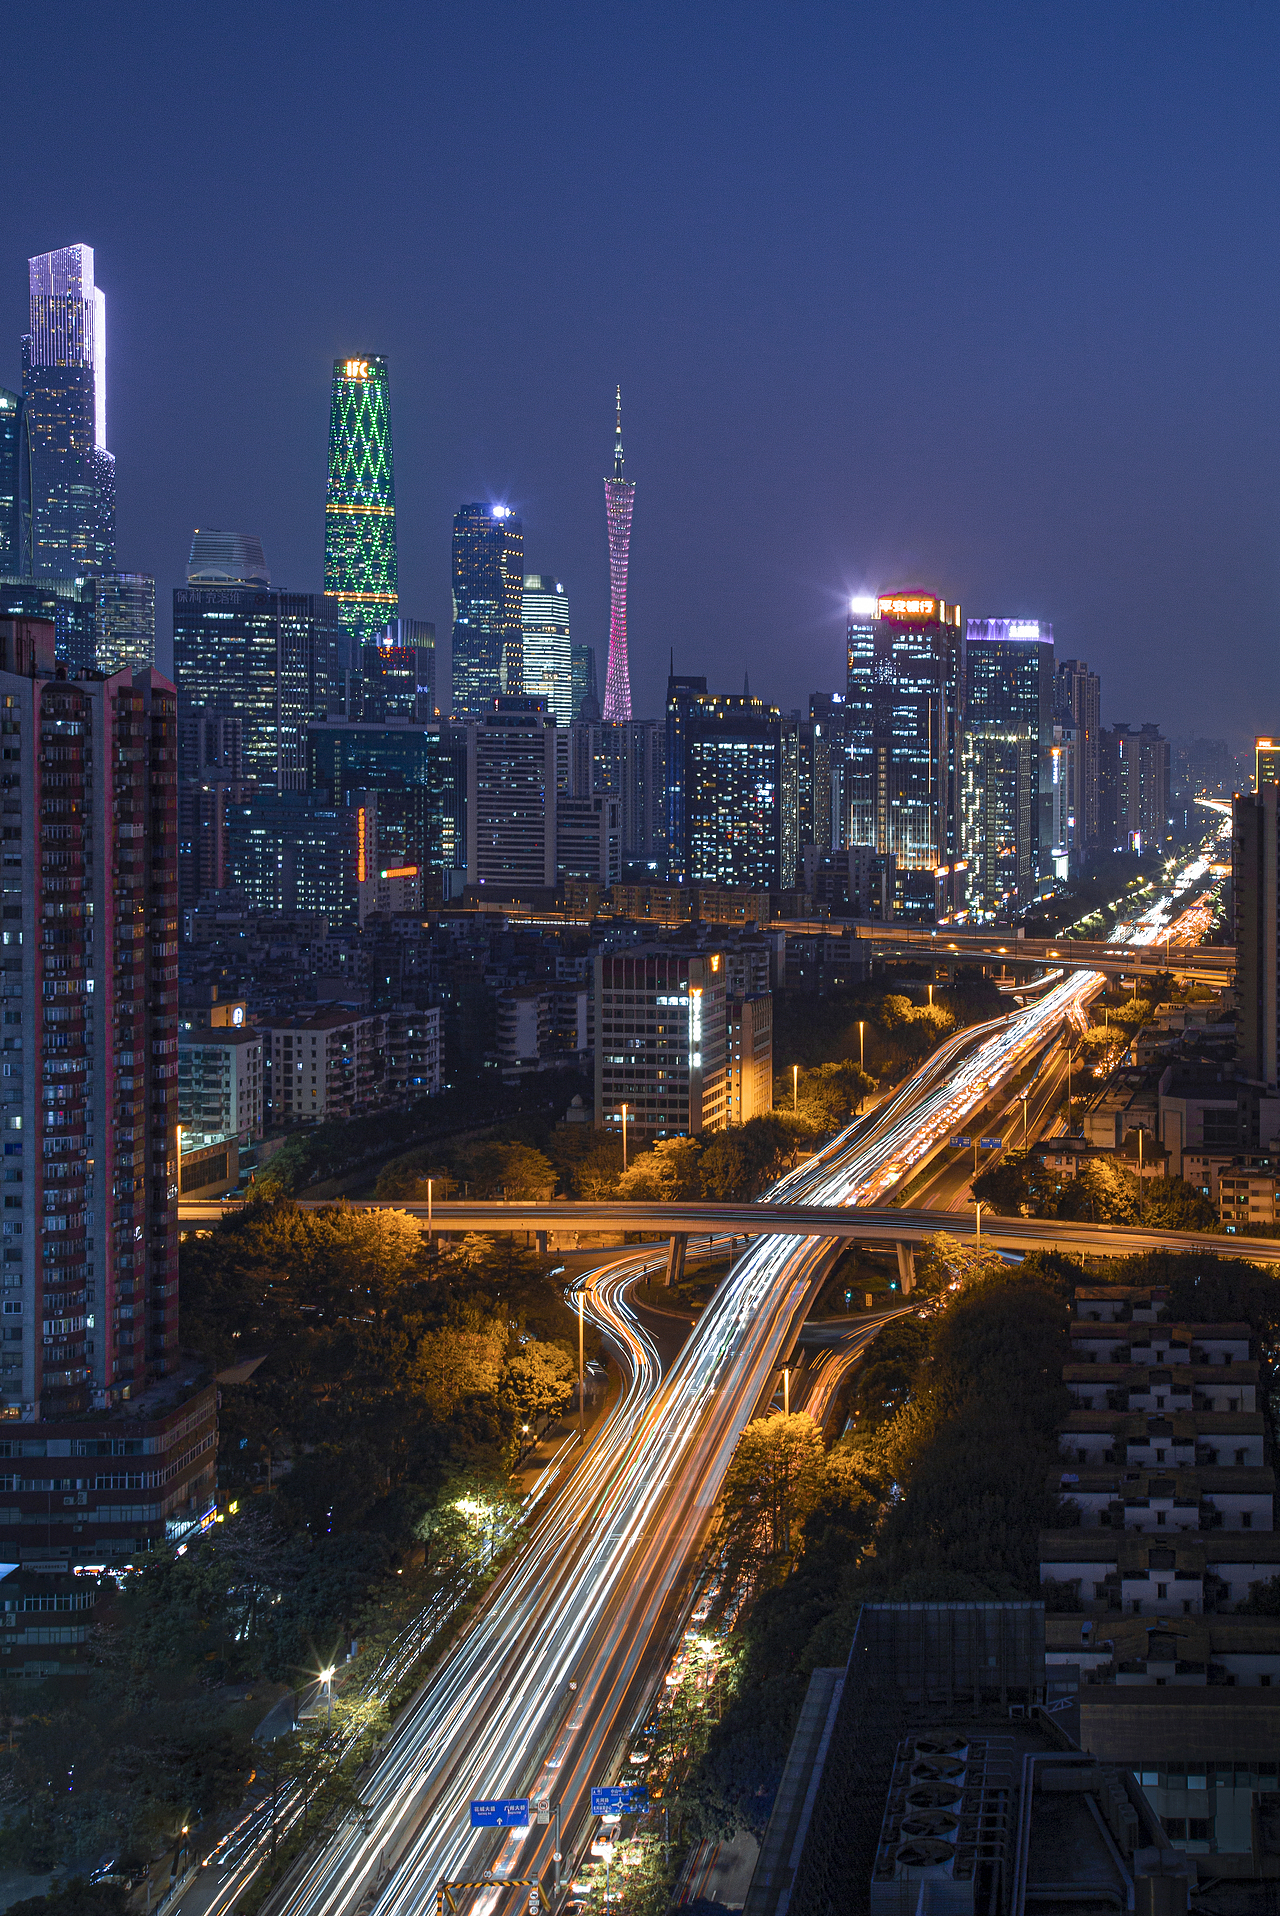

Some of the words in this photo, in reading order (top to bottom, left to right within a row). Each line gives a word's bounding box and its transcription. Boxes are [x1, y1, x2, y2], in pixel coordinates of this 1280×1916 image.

[346, 361, 368, 378] IFC
[878, 599, 934, 613] 平安银行
